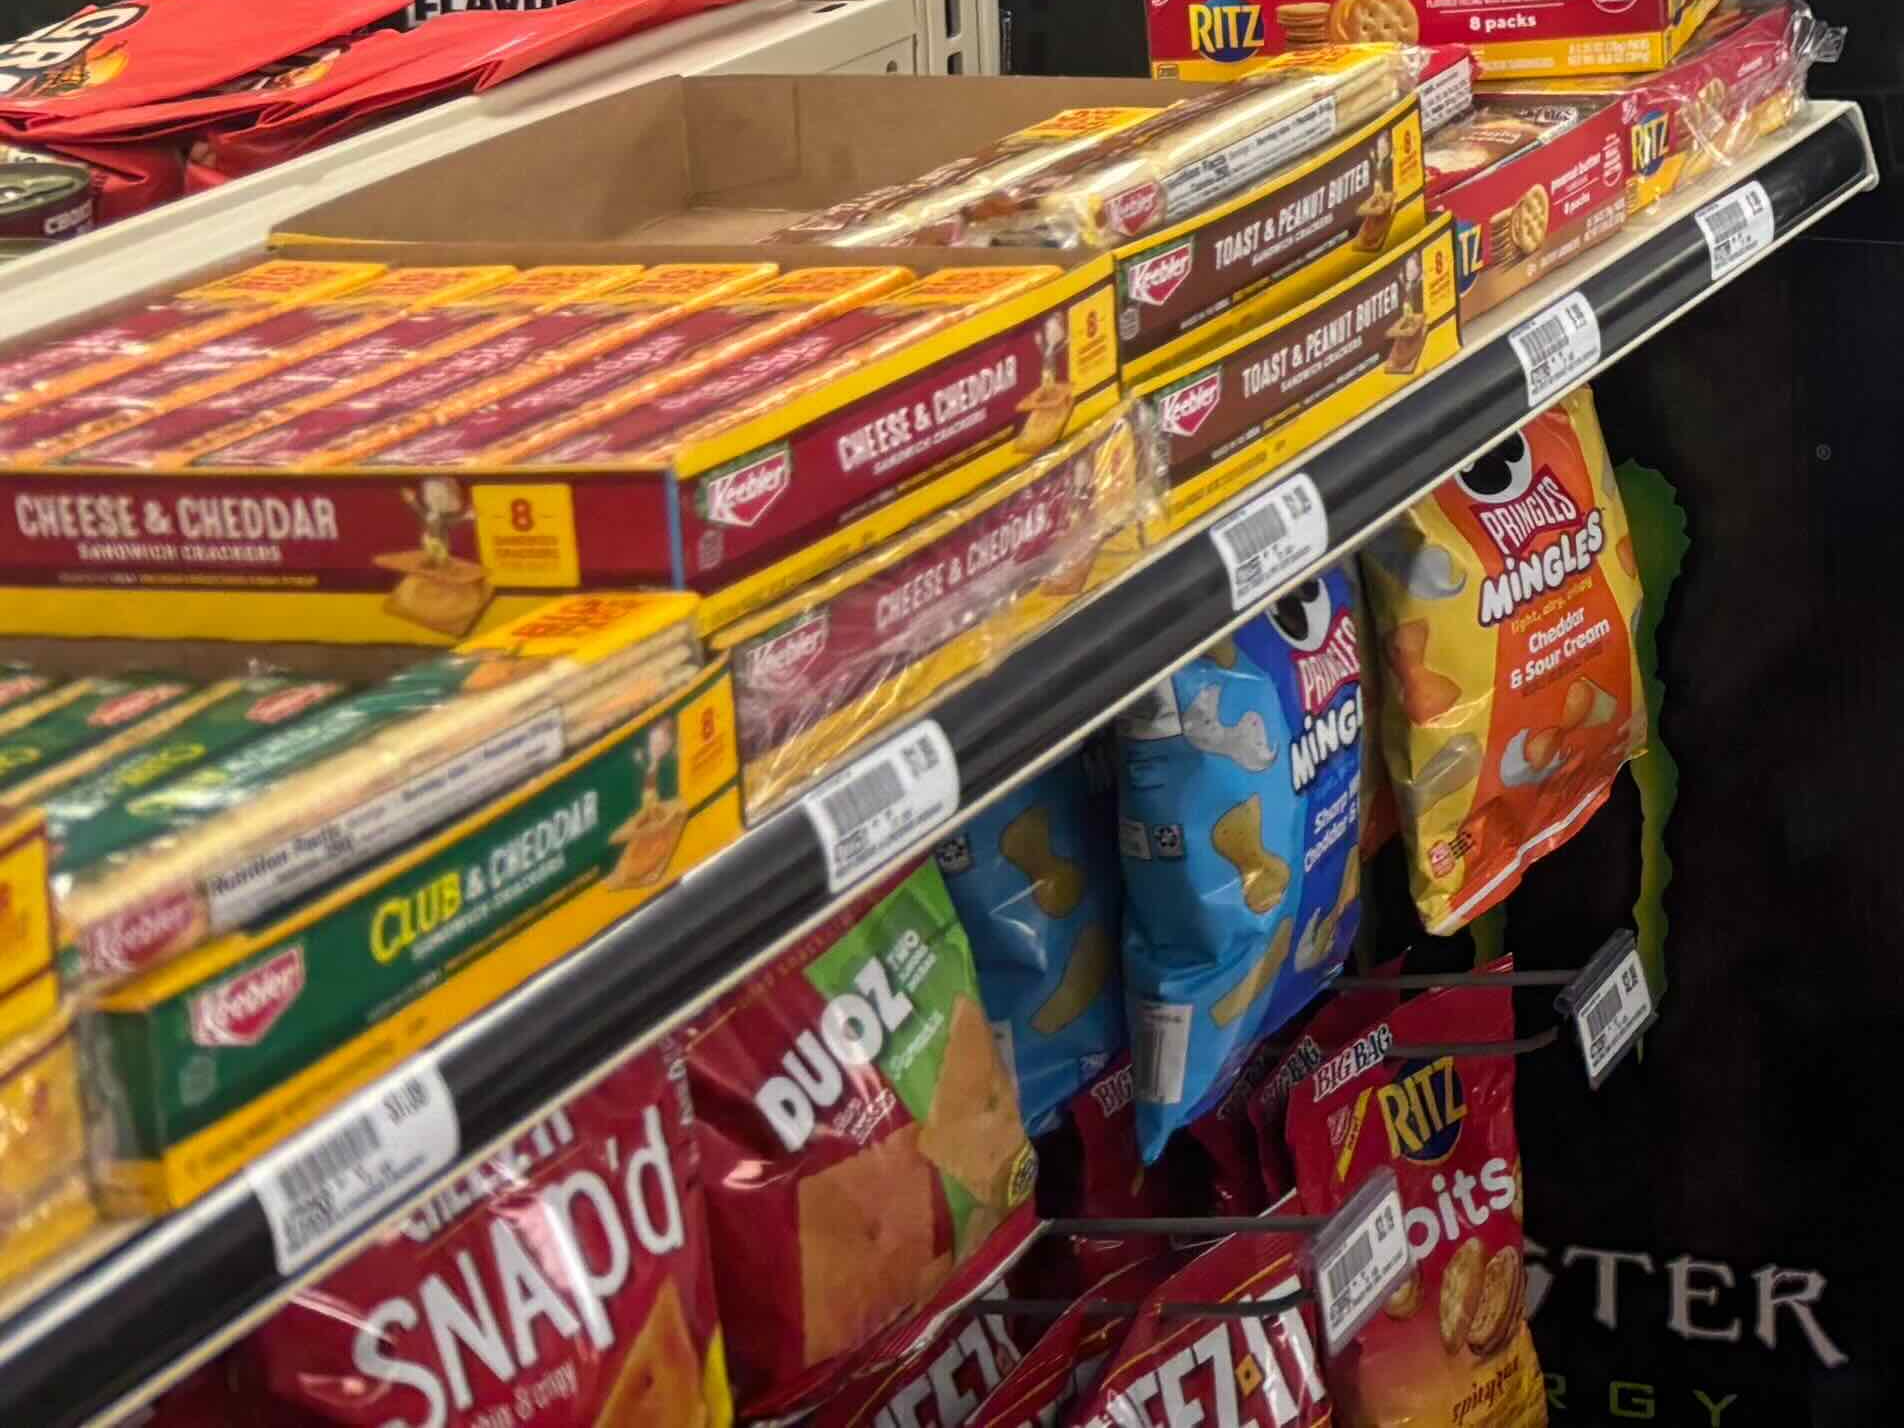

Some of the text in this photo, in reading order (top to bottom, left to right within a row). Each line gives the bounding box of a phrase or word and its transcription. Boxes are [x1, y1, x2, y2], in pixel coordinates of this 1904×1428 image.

[1188, 3, 1264, 54] RITZ
[1470, 14, 1537, 34] 8 packs
[1632, 111, 1669, 172] RITZ
[1214, 161, 1371, 272] TOAST & PEANUT BUTTER
[1128, 250, 1193, 299] Keebler
[1242, 281, 1399, 400] TOAST & PEANUT BUTTER
[838, 356, 1017, 471] CHEESE & CHEDDAR
[1161, 380, 1220, 424] Keebler
[706, 452, 790, 516] Keebler
[1480, 475, 1578, 555] PRINGLES
[16, 494, 338, 541] CHEESE & CHEDDAR
[511, 499, 535, 532] 8
[78, 545, 280, 563] SANDWICH CRACKERS
[875, 578, 944, 637] CHEESE
[1529, 607, 1585, 654] Cheddar
[1510, 618, 1610, 689] & Sour Cream
[371, 791, 598, 964] CLUB CHEDDAR
[755, 956, 914, 1153] DUOZ
[1313, 1023, 1393, 1103] BIG BAG
[1376, 1056, 1467, 1158] RITZ
